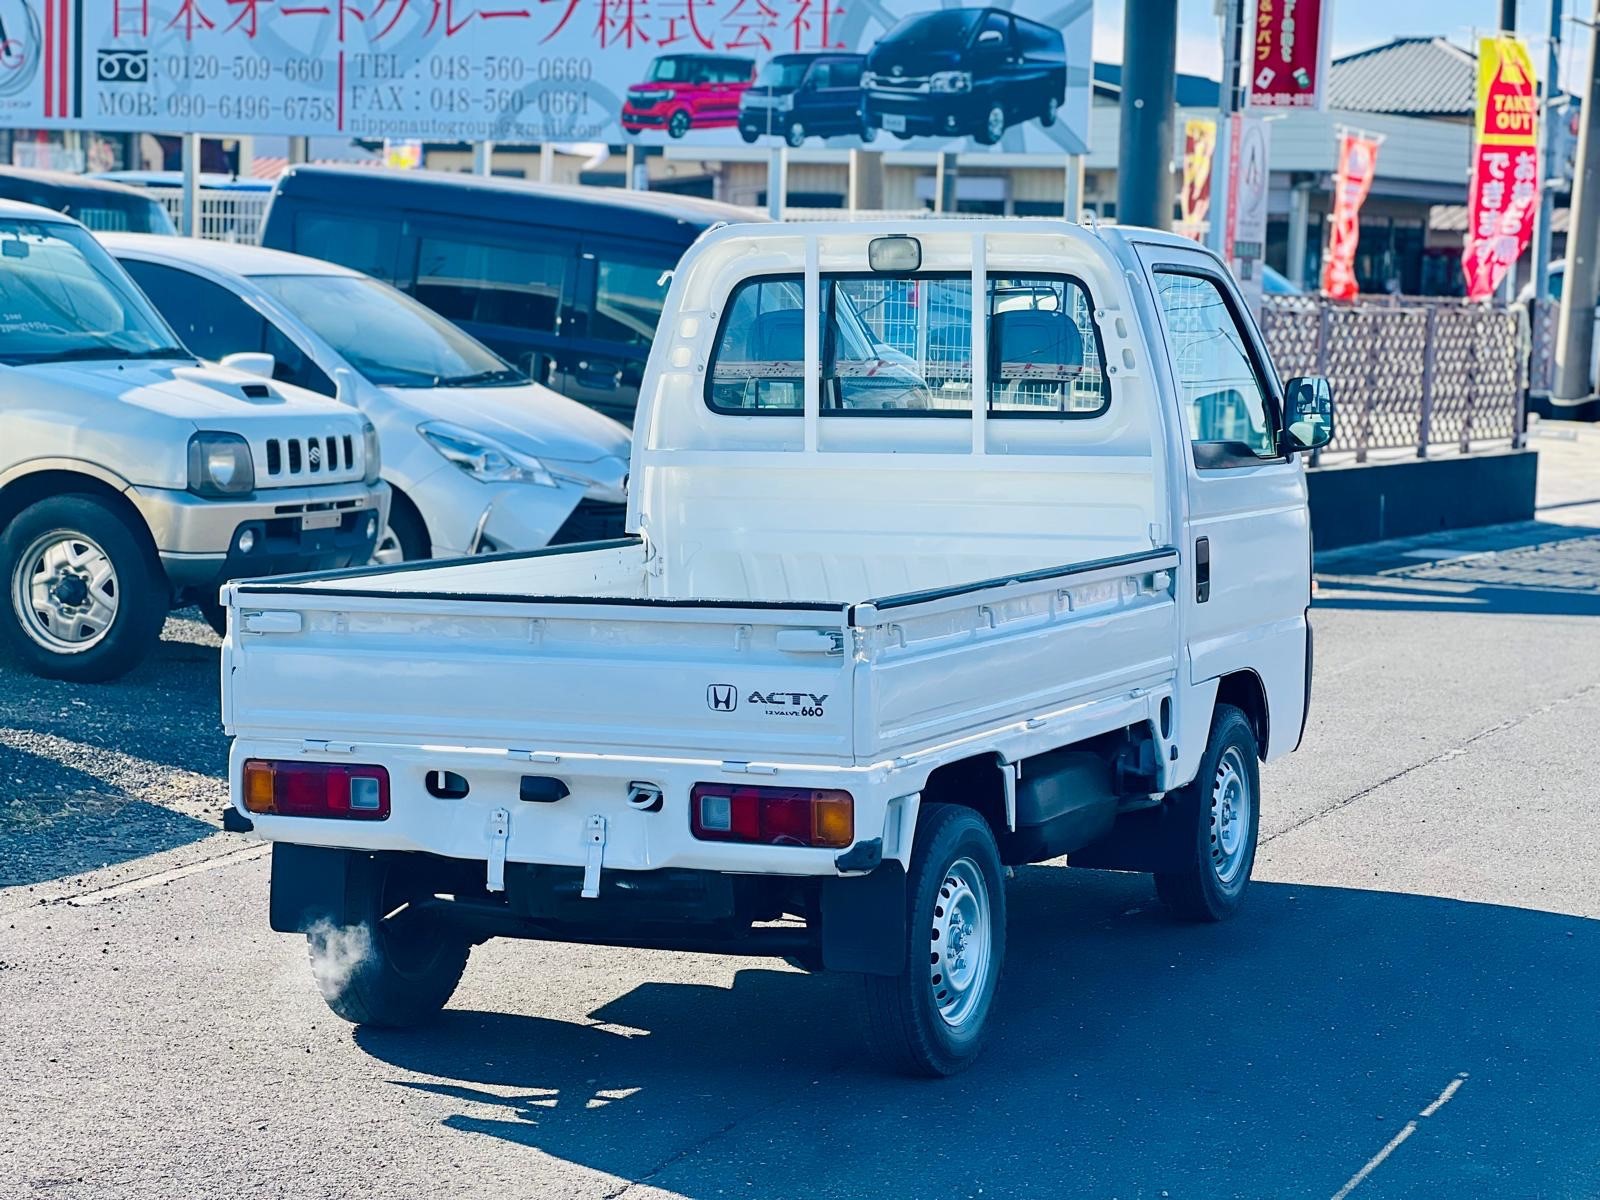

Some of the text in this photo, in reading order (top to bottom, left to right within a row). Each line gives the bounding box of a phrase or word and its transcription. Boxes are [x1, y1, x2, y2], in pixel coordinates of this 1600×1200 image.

[167, 55, 324, 82] 0120-509-660
[430, 55, 592, 81] 048-560-0660
[166, 96, 336, 122] 090-6496-6758
[430, 87, 590, 115] 048-560-0661
[1493, 94, 1533, 112] TAKE
[350, 113, 603, 138] nipponautogroup@gmail.com
[1496, 113, 1532, 131] OUT
[748, 691, 829, 707] ACTY
[801, 706, 824, 718] 660
